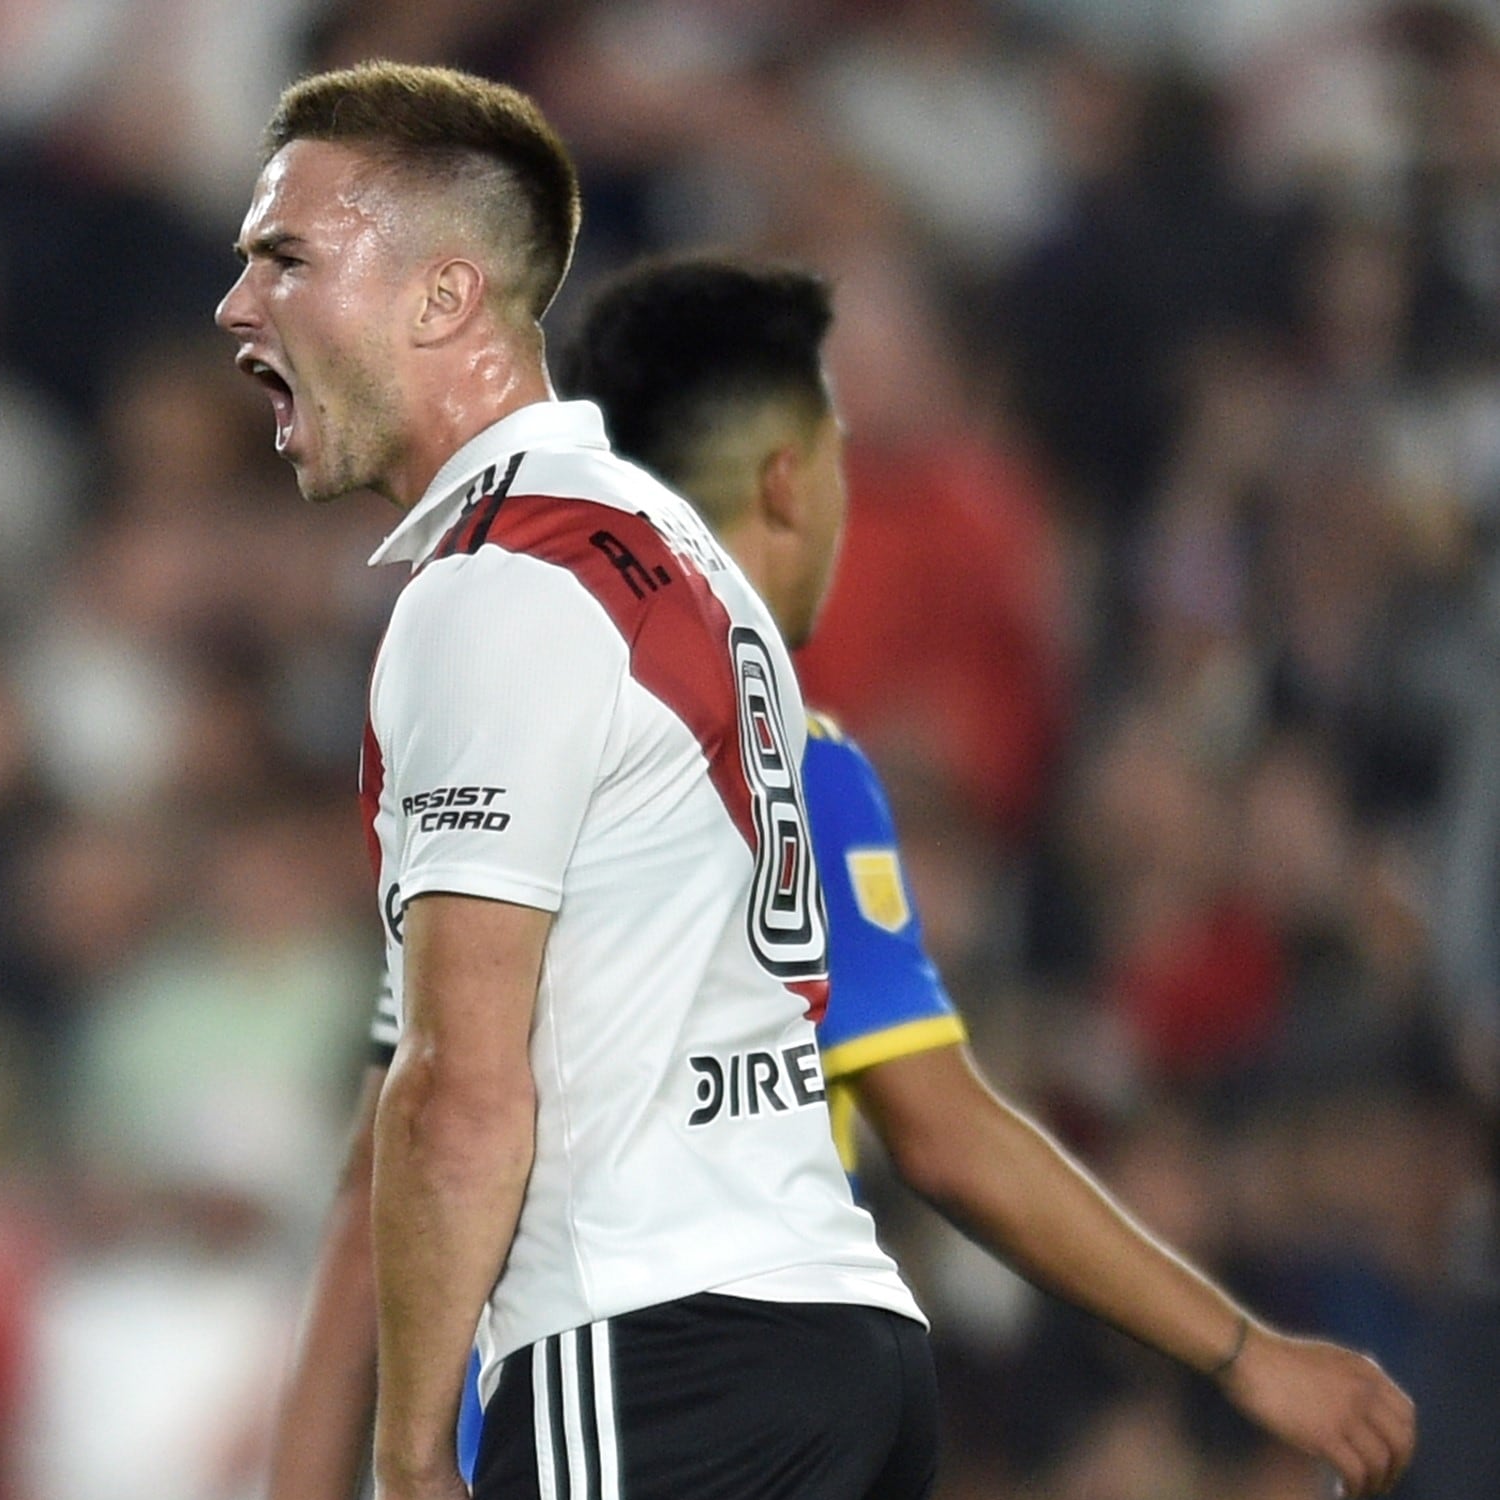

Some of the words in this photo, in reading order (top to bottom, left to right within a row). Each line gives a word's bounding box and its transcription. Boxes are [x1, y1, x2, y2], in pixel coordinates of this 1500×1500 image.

[402, 787, 506, 817] ASSIST
[730, 627, 829, 979] 8
[421, 811, 511, 832] CARD
